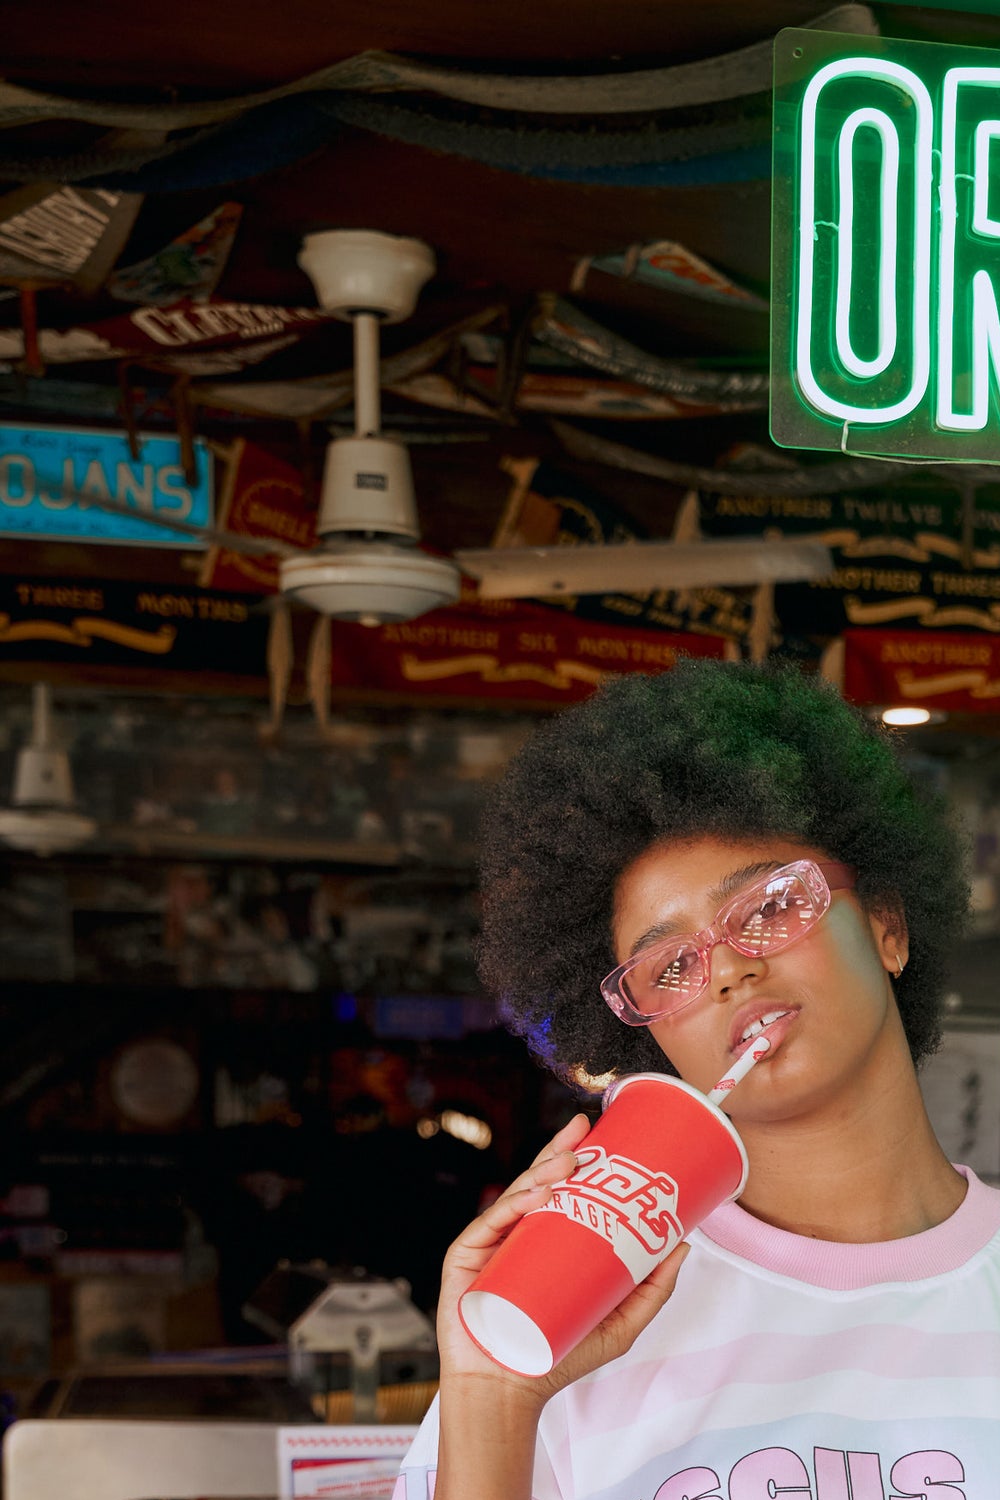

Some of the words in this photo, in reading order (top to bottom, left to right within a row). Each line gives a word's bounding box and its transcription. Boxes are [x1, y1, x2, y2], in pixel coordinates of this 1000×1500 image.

[14, 581, 106, 612] THREE
[134, 590, 249, 624] MONTHS
[379, 621, 501, 650] ANOTHER
[880, 639, 994, 668] ANOTHER
[541, 1193, 614, 1240] RAGE
